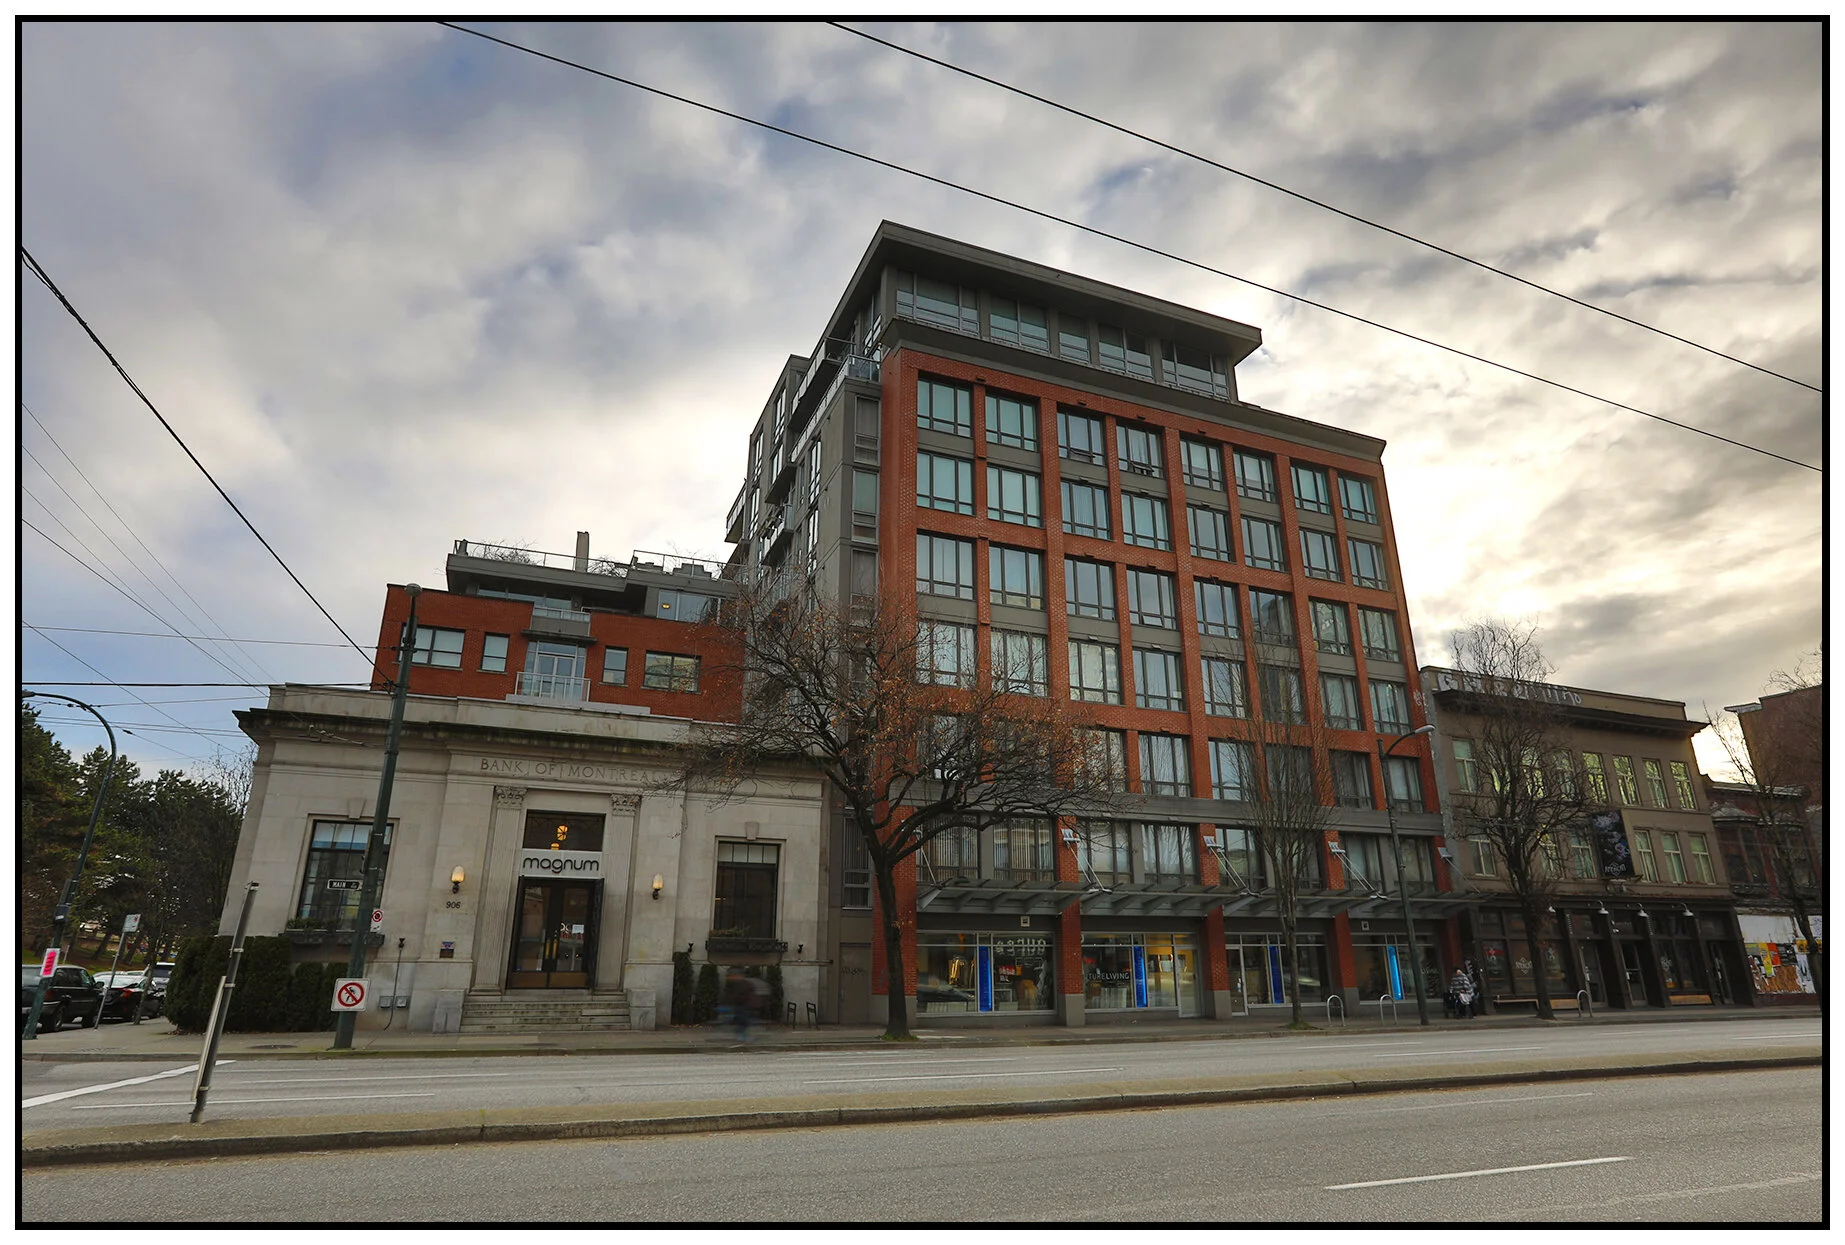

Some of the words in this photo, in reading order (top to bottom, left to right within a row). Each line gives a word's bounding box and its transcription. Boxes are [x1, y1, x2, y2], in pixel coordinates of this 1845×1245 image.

[480, 758, 524, 774] BANK
[535, 762, 555, 776] OF
[567, 765, 659, 783] MONTREAL
[522, 856, 600, 873] magnum
[445, 901, 461, 909] 906
